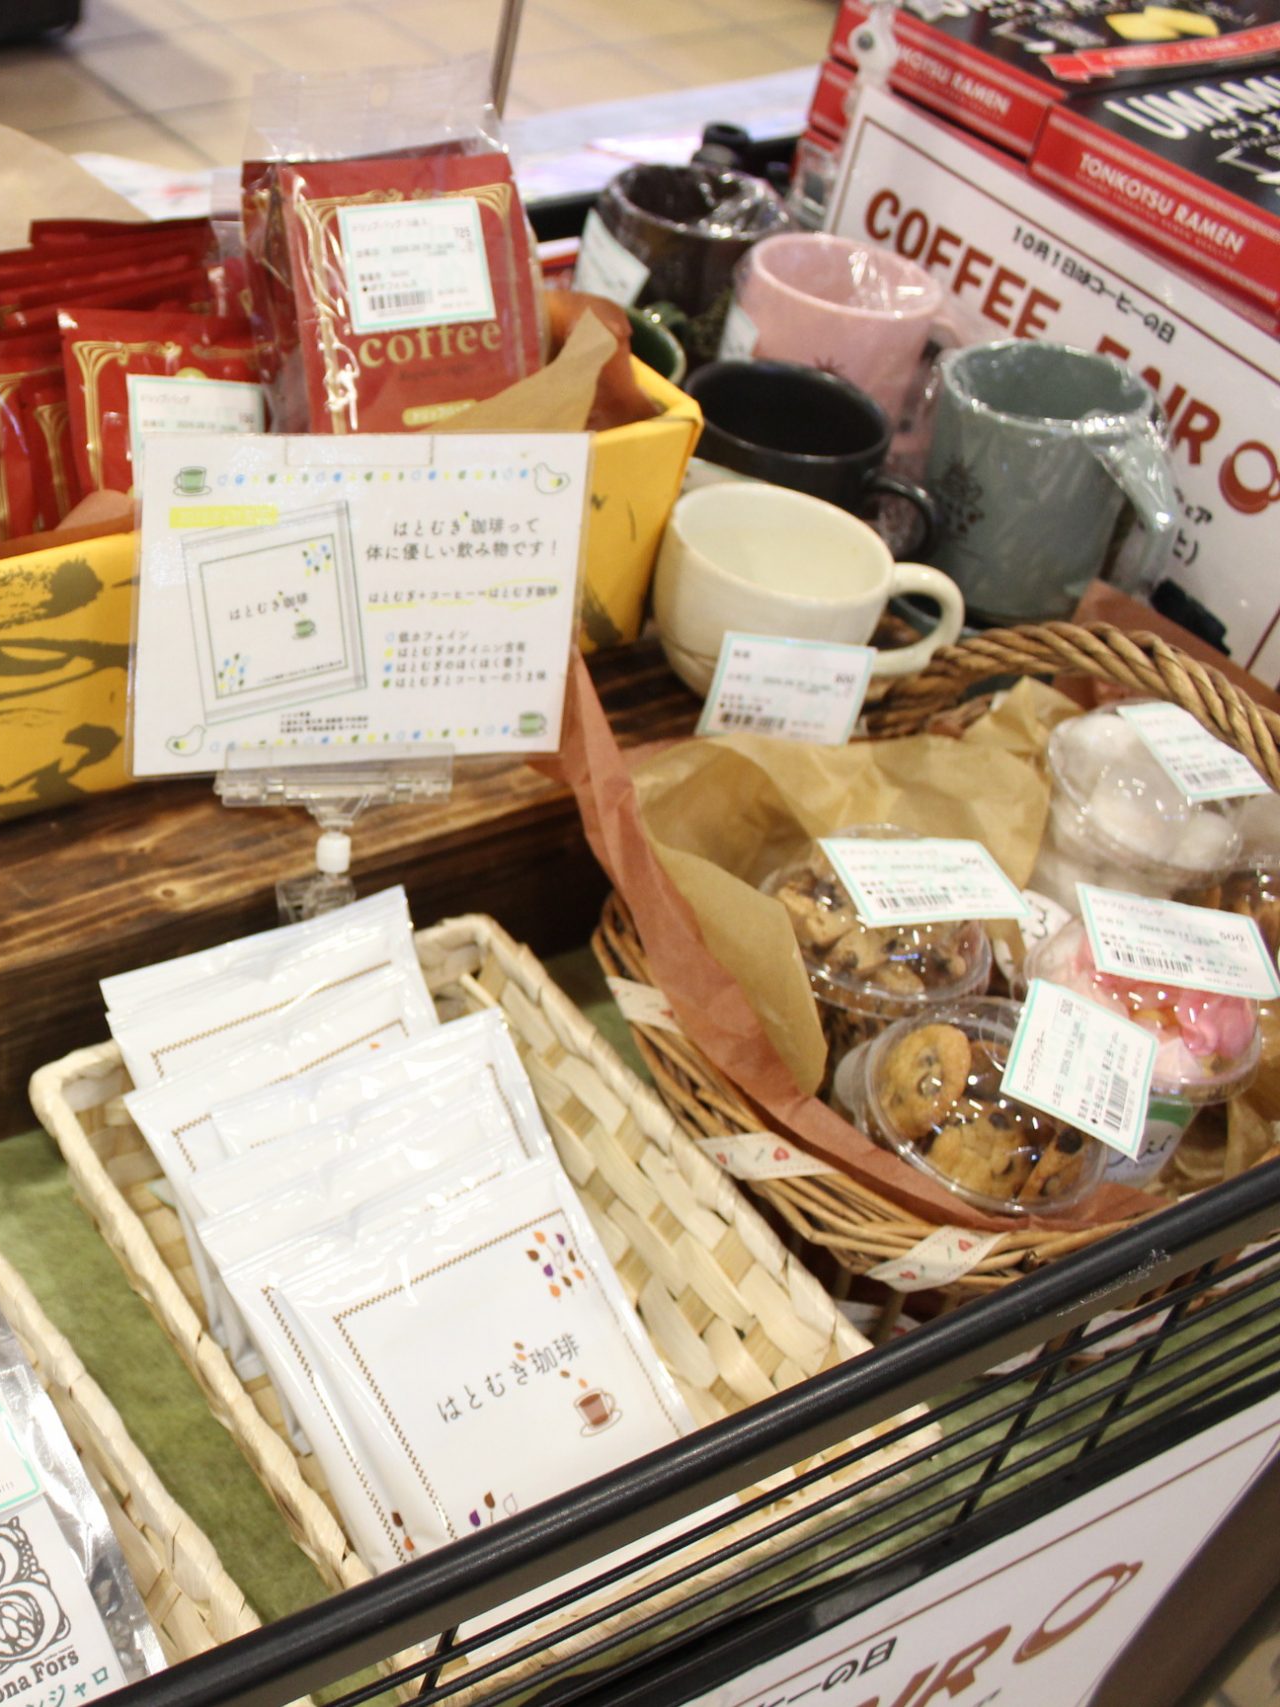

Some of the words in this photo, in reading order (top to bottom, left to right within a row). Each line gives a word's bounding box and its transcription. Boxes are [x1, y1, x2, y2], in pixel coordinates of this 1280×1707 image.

[1103, 76, 1280, 140] UMAM
[1079, 151, 1174, 218] TONKOTSU
[1173, 203, 1246, 254] RAMEN
[865, 189, 1061, 339] COFFEE
[1011, 225, 1177, 345] 10月1日はコーヒーの日
[358, 322, 502, 368] coffee
[436, 1333, 580, 1424] はとむぎ珈琲
[29, 1650, 80, 1685] Fors
